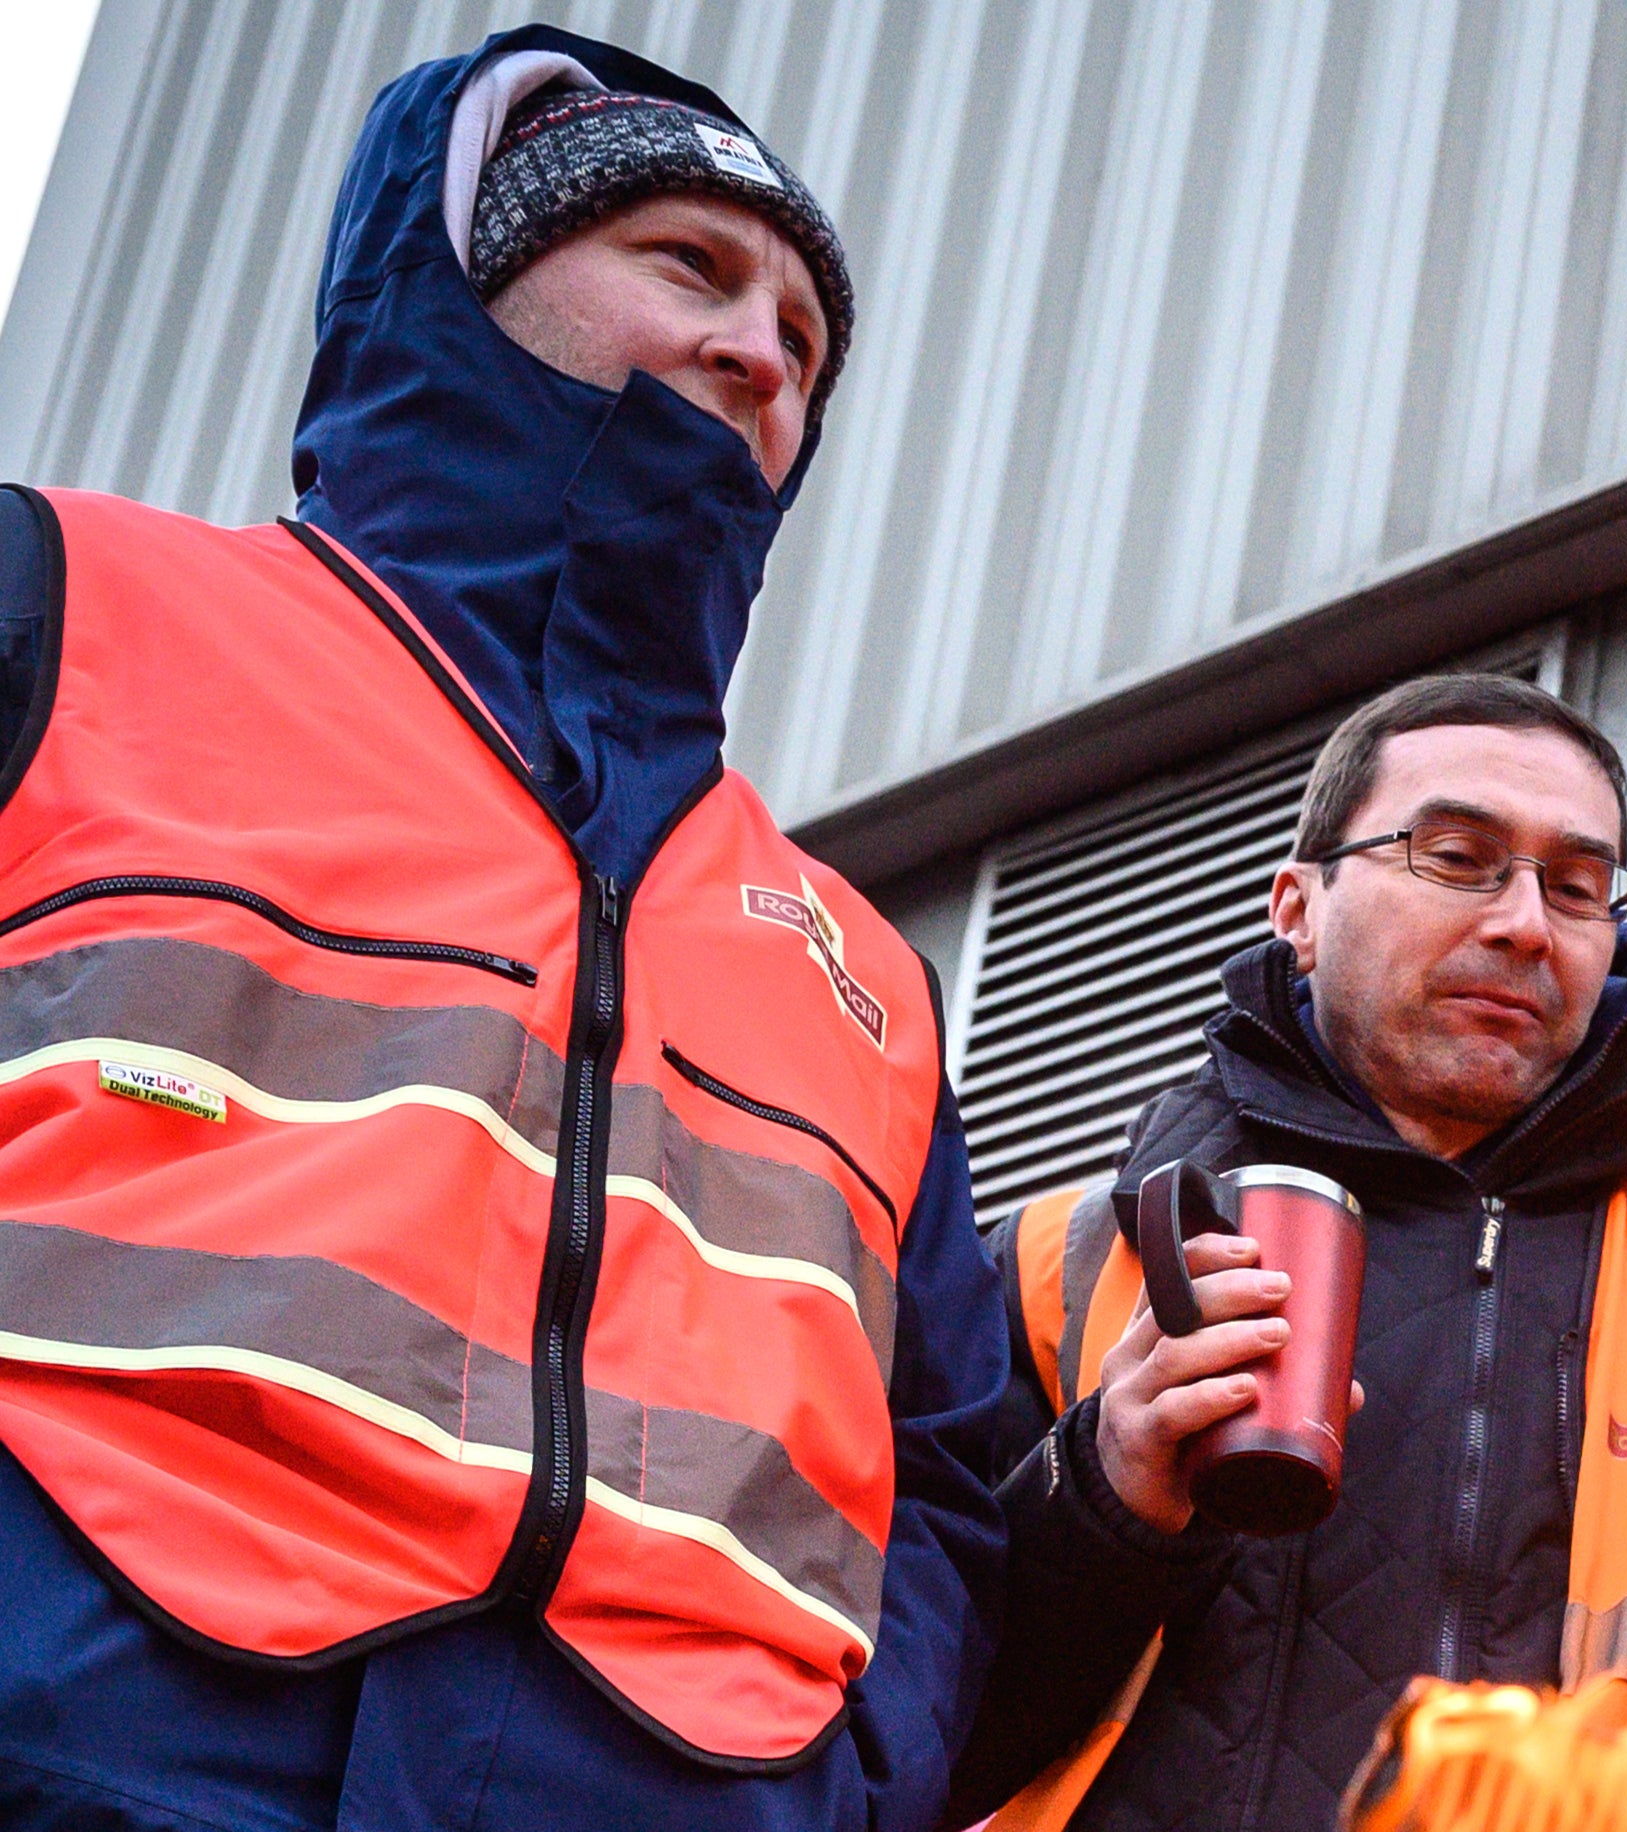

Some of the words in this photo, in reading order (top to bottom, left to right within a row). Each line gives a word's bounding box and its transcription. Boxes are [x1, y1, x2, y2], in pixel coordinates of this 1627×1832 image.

[758, 893, 826, 956] Roy
[832, 963, 878, 1029] Mail
[109, 1079, 140, 1097] Dual
[143, 1090, 218, 1120] Technology
[199, 1089, 221, 1106] DT
